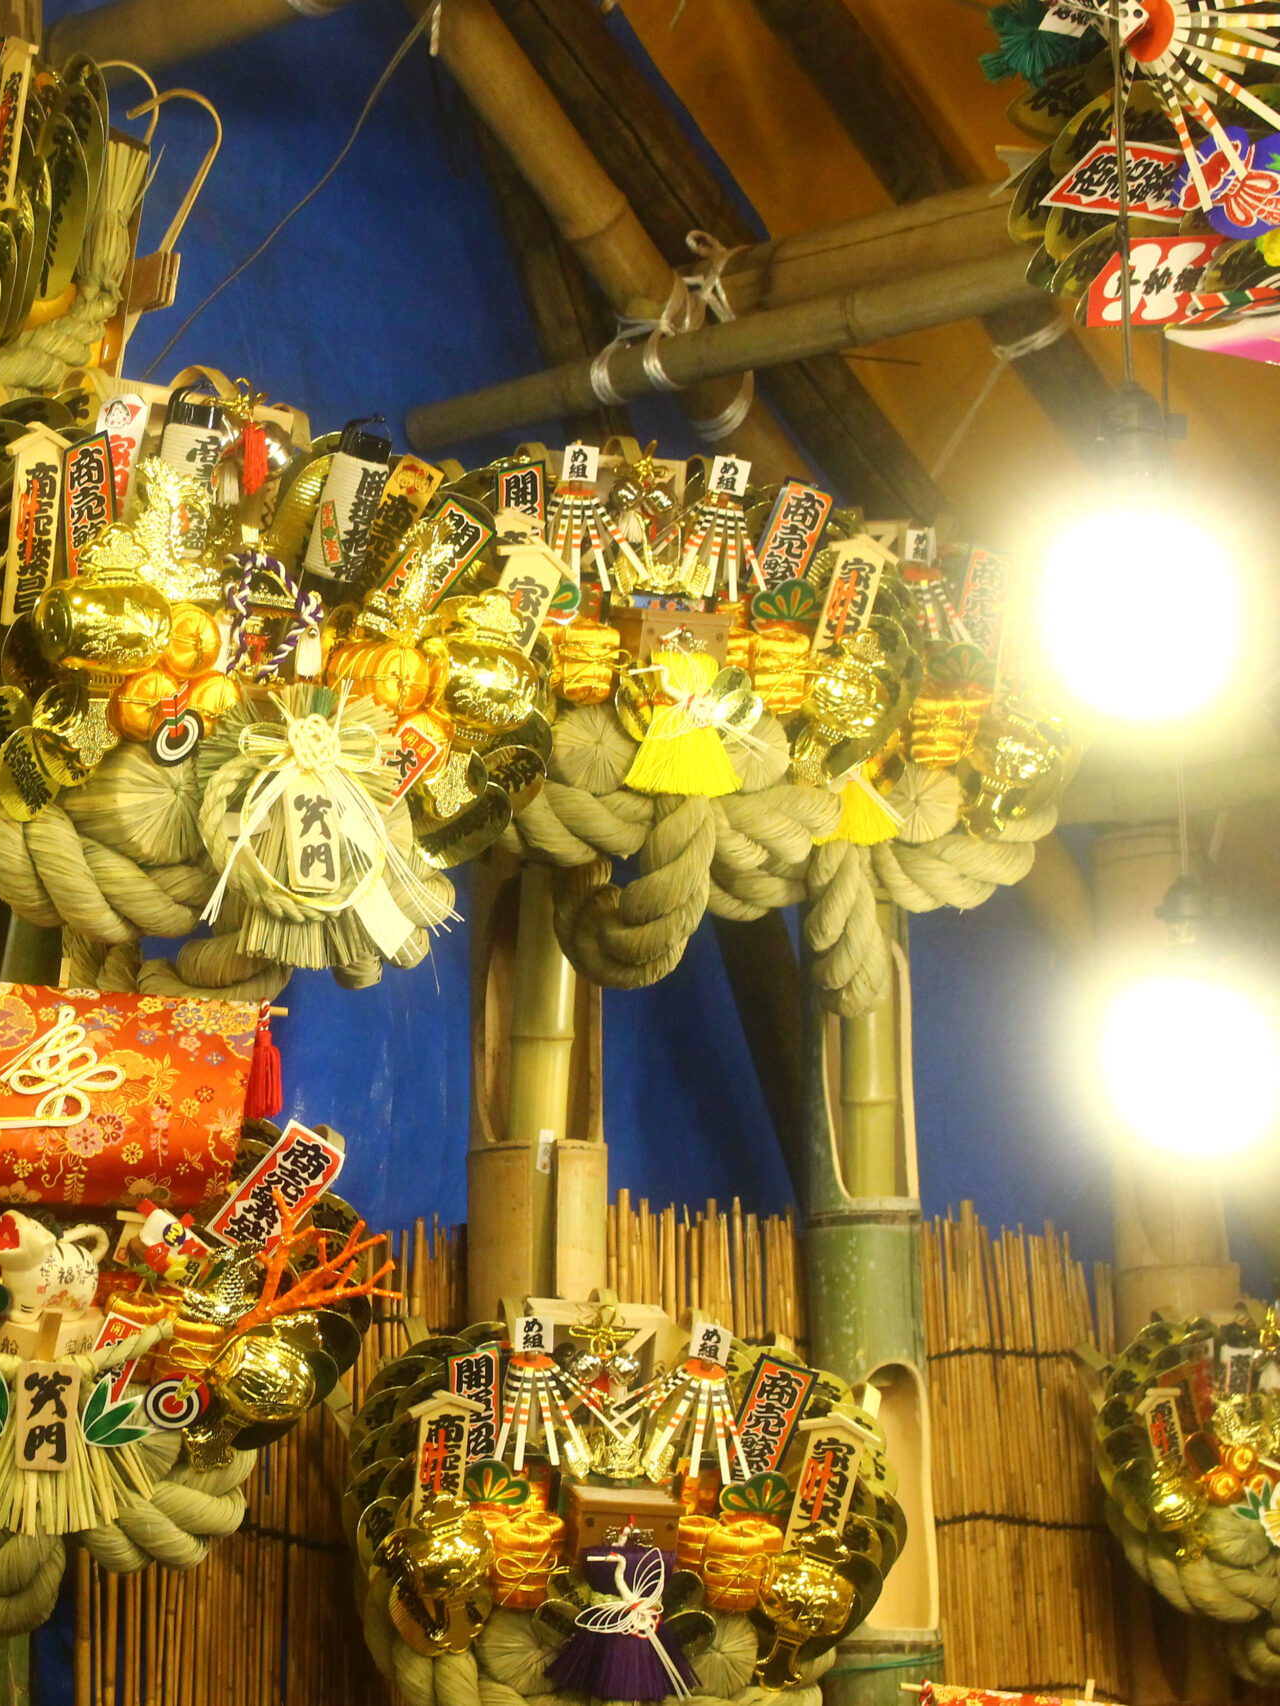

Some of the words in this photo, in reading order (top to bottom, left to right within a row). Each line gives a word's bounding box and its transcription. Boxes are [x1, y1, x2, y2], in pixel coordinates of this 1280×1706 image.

[569, 448, 589, 480] め組
[715, 460, 740, 493] め組
[522, 1317, 545, 1350] め組
[696, 1328, 721, 1360] め組
[455, 1353, 496, 1467] 開運招
